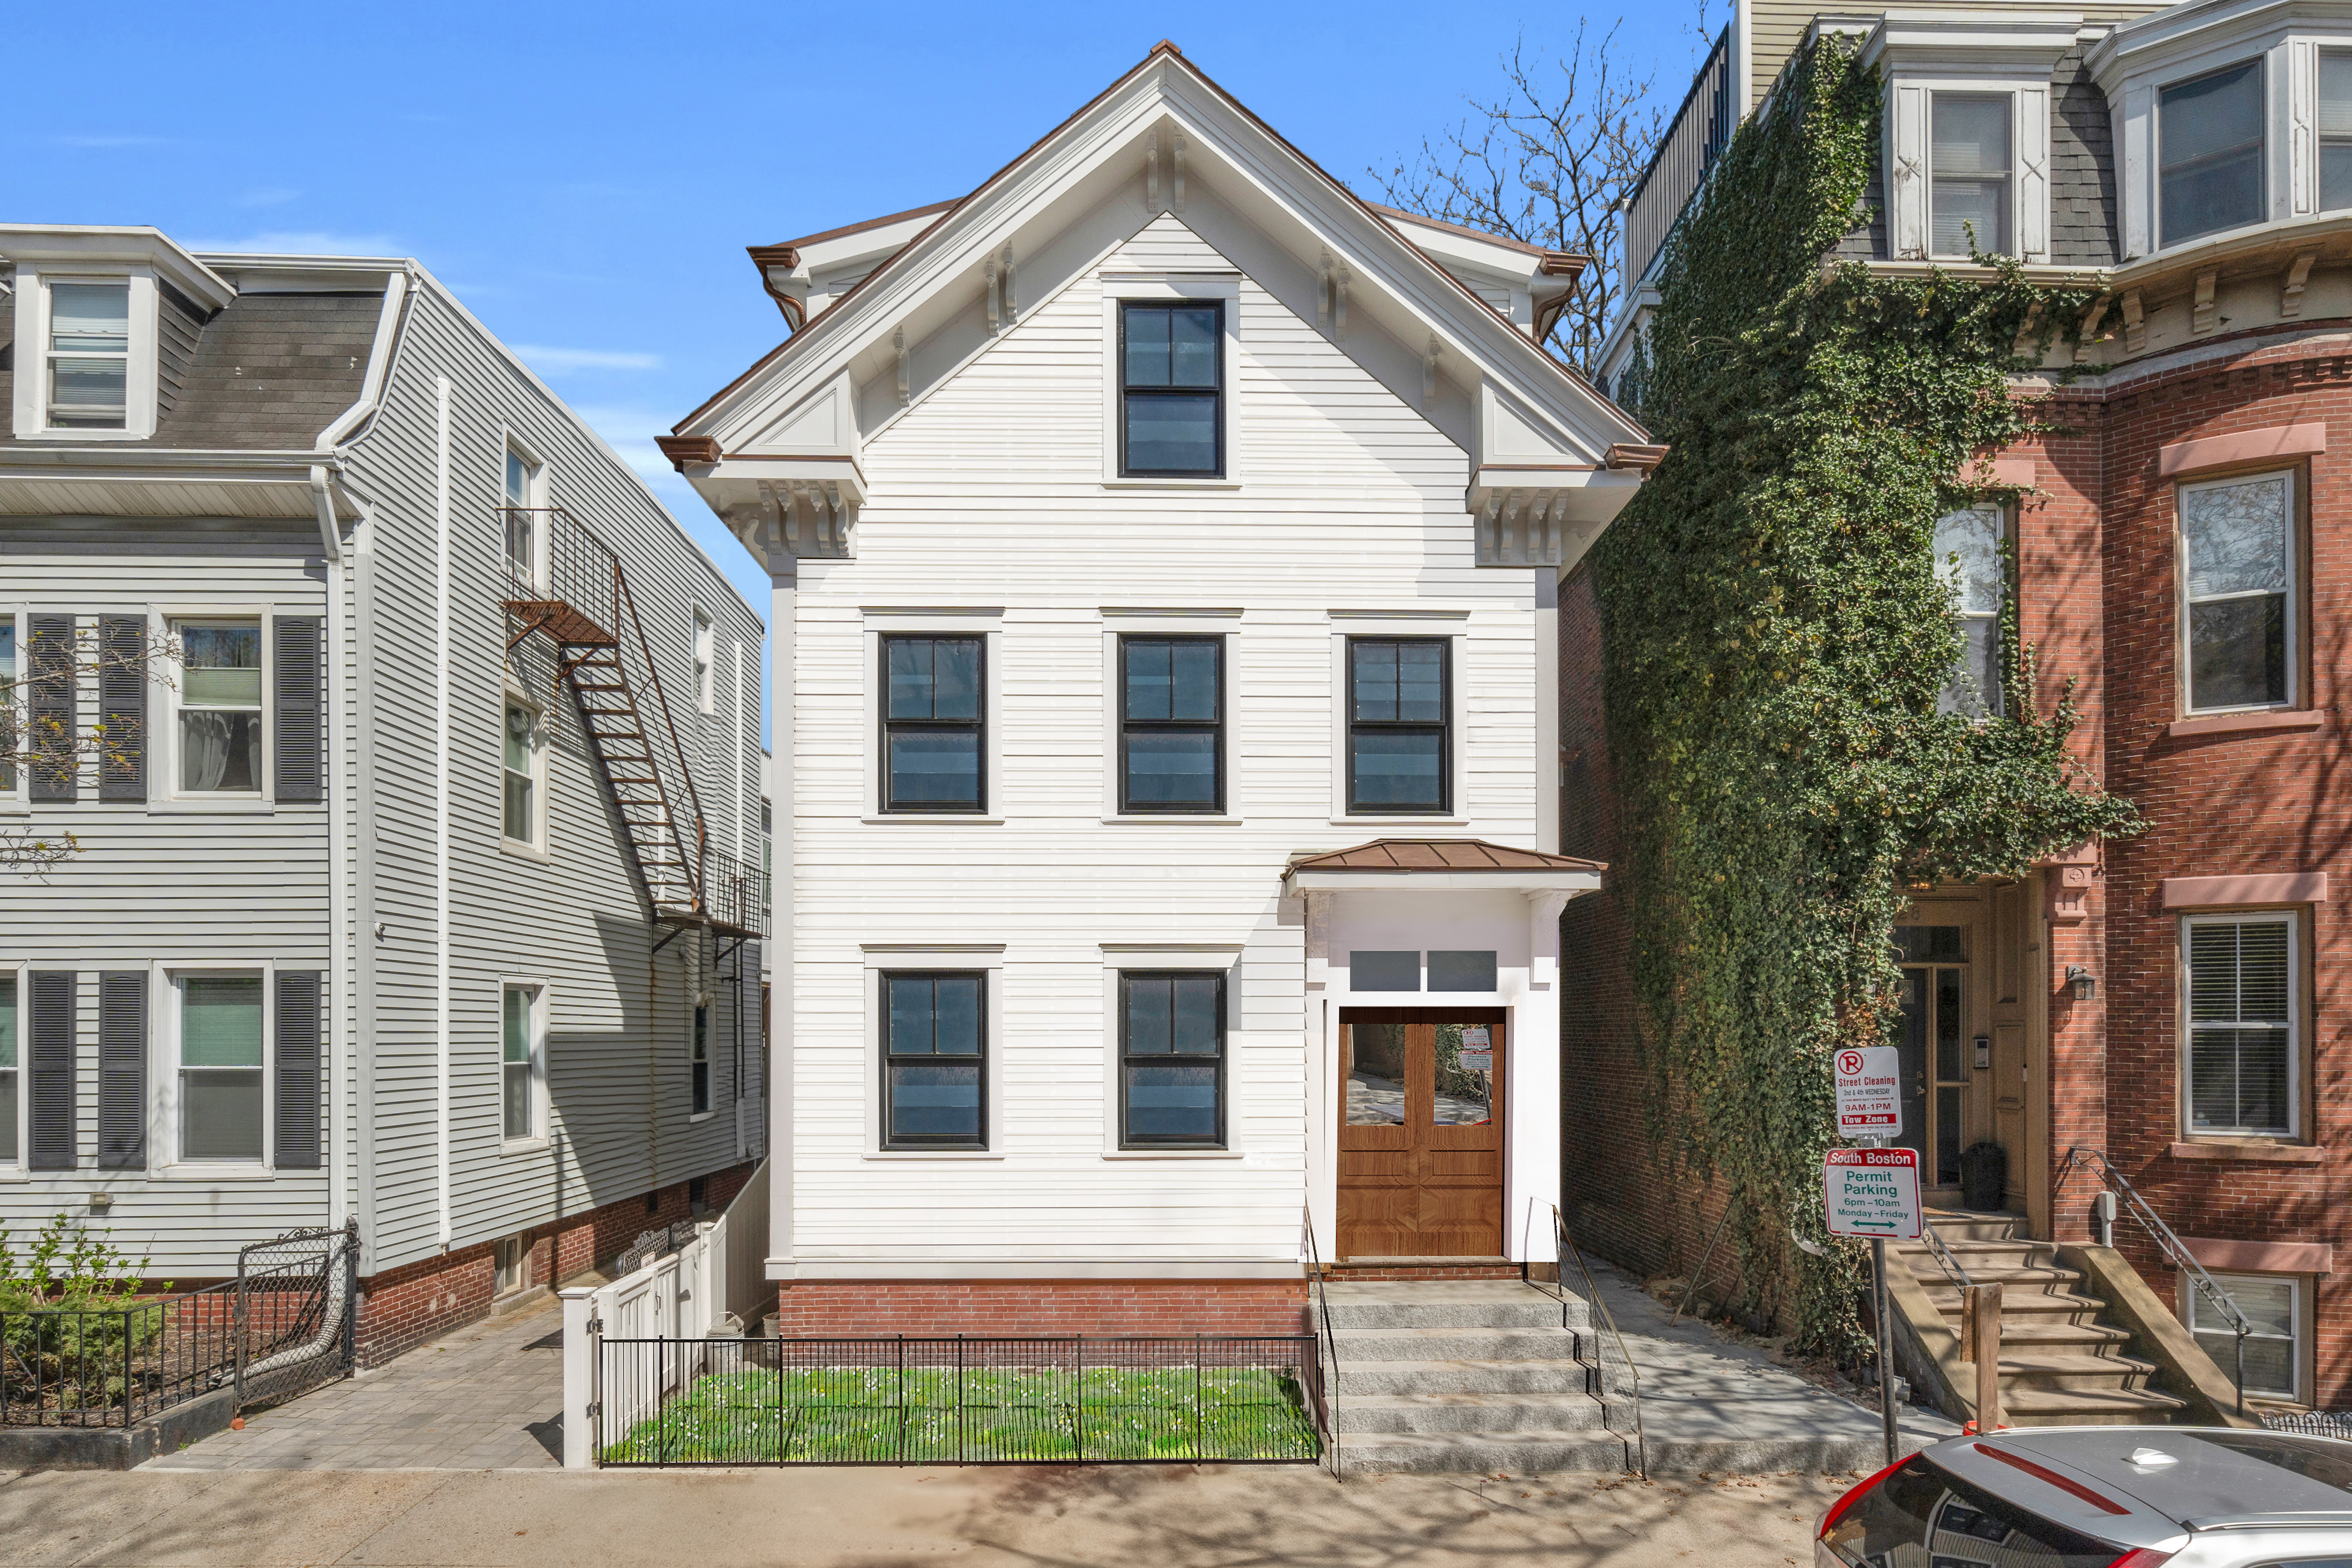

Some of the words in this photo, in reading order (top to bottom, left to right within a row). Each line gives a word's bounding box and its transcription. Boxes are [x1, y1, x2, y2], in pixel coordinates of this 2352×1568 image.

[1839, 1077, 1861, 1087] Street
[1864, 1076, 1896, 1086] Cleaning
[1830, 1152, 1862, 1163] South
[1866, 1153, 1910, 1164] Boston
[1846, 1171, 1893, 1182] Permit
[1844, 1184, 1897, 1198] Parking
